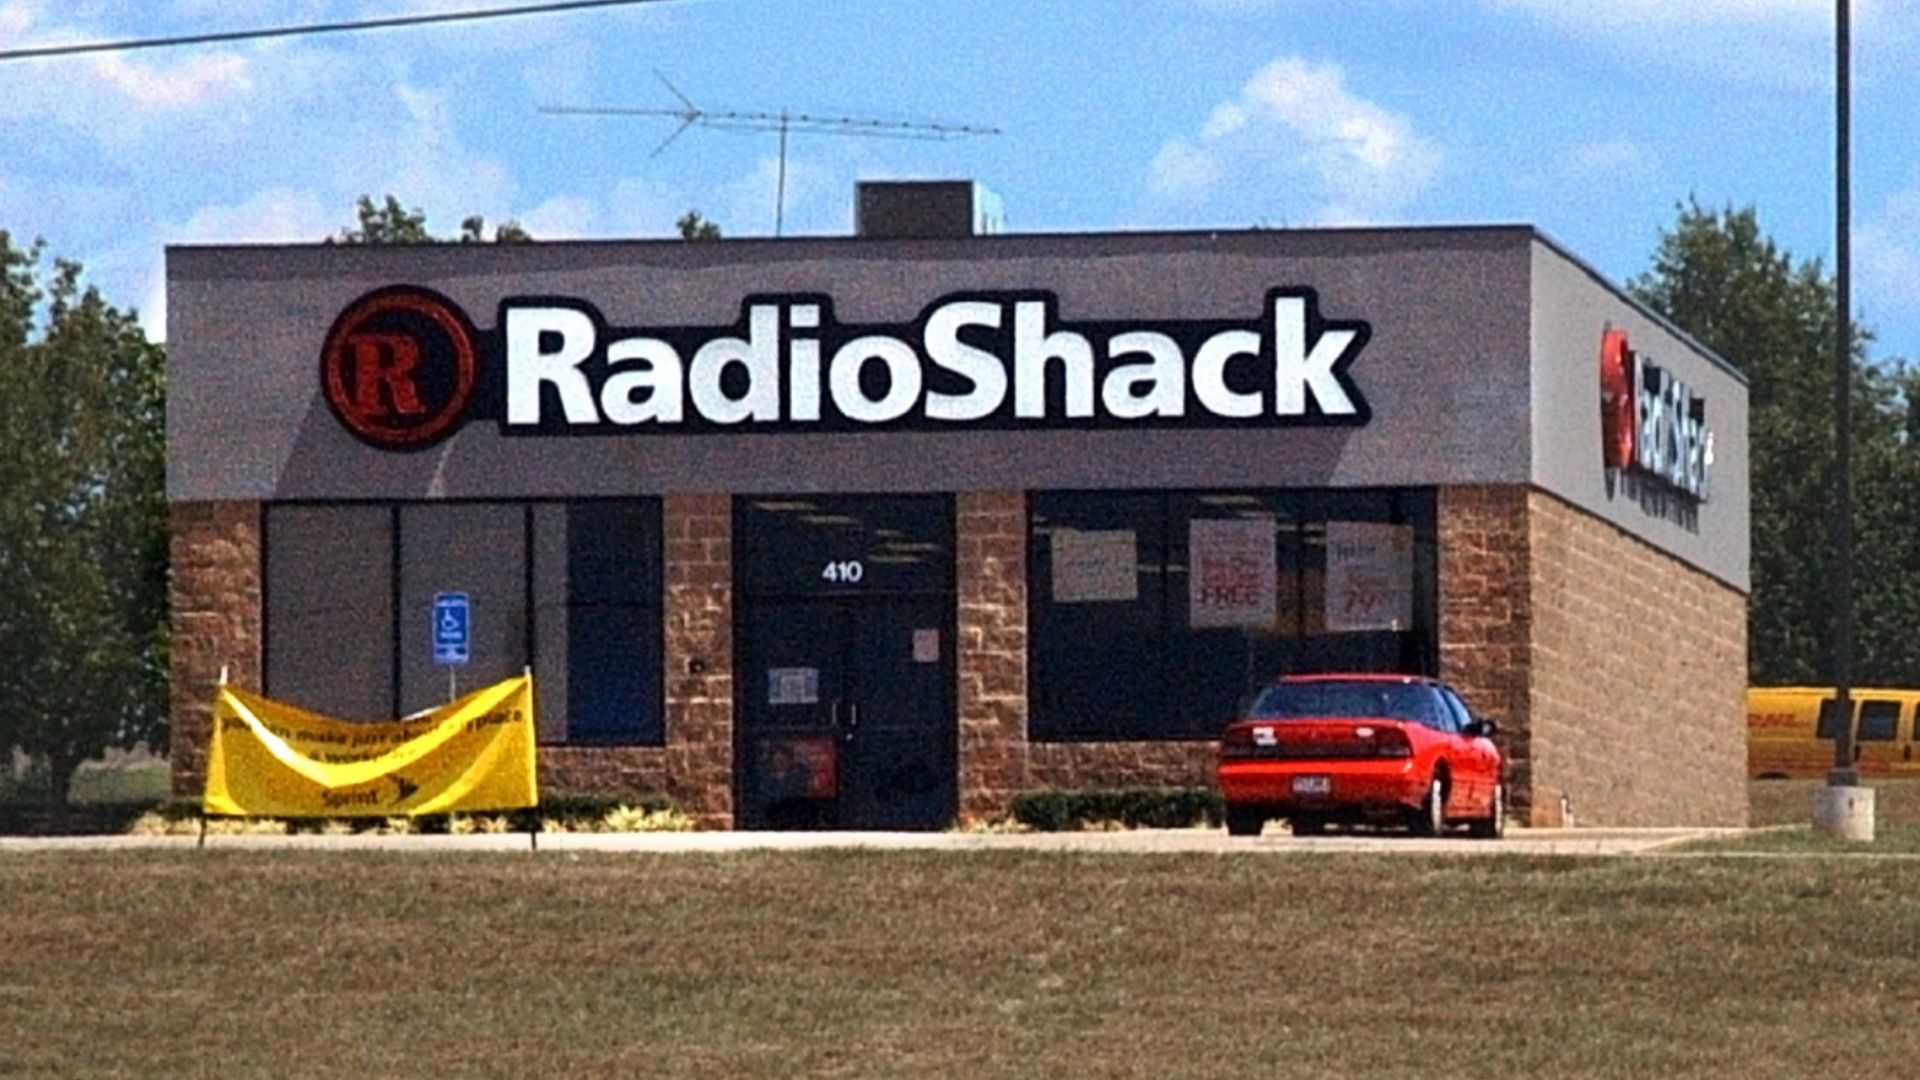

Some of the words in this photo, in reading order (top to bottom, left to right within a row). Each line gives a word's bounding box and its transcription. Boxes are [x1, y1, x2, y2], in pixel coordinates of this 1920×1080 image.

[507, 296, 1357, 425] RadioShack
[822, 560, 863, 582] 410
[296, 730, 347, 745] make
[321, 788, 379, 808] Sprint
